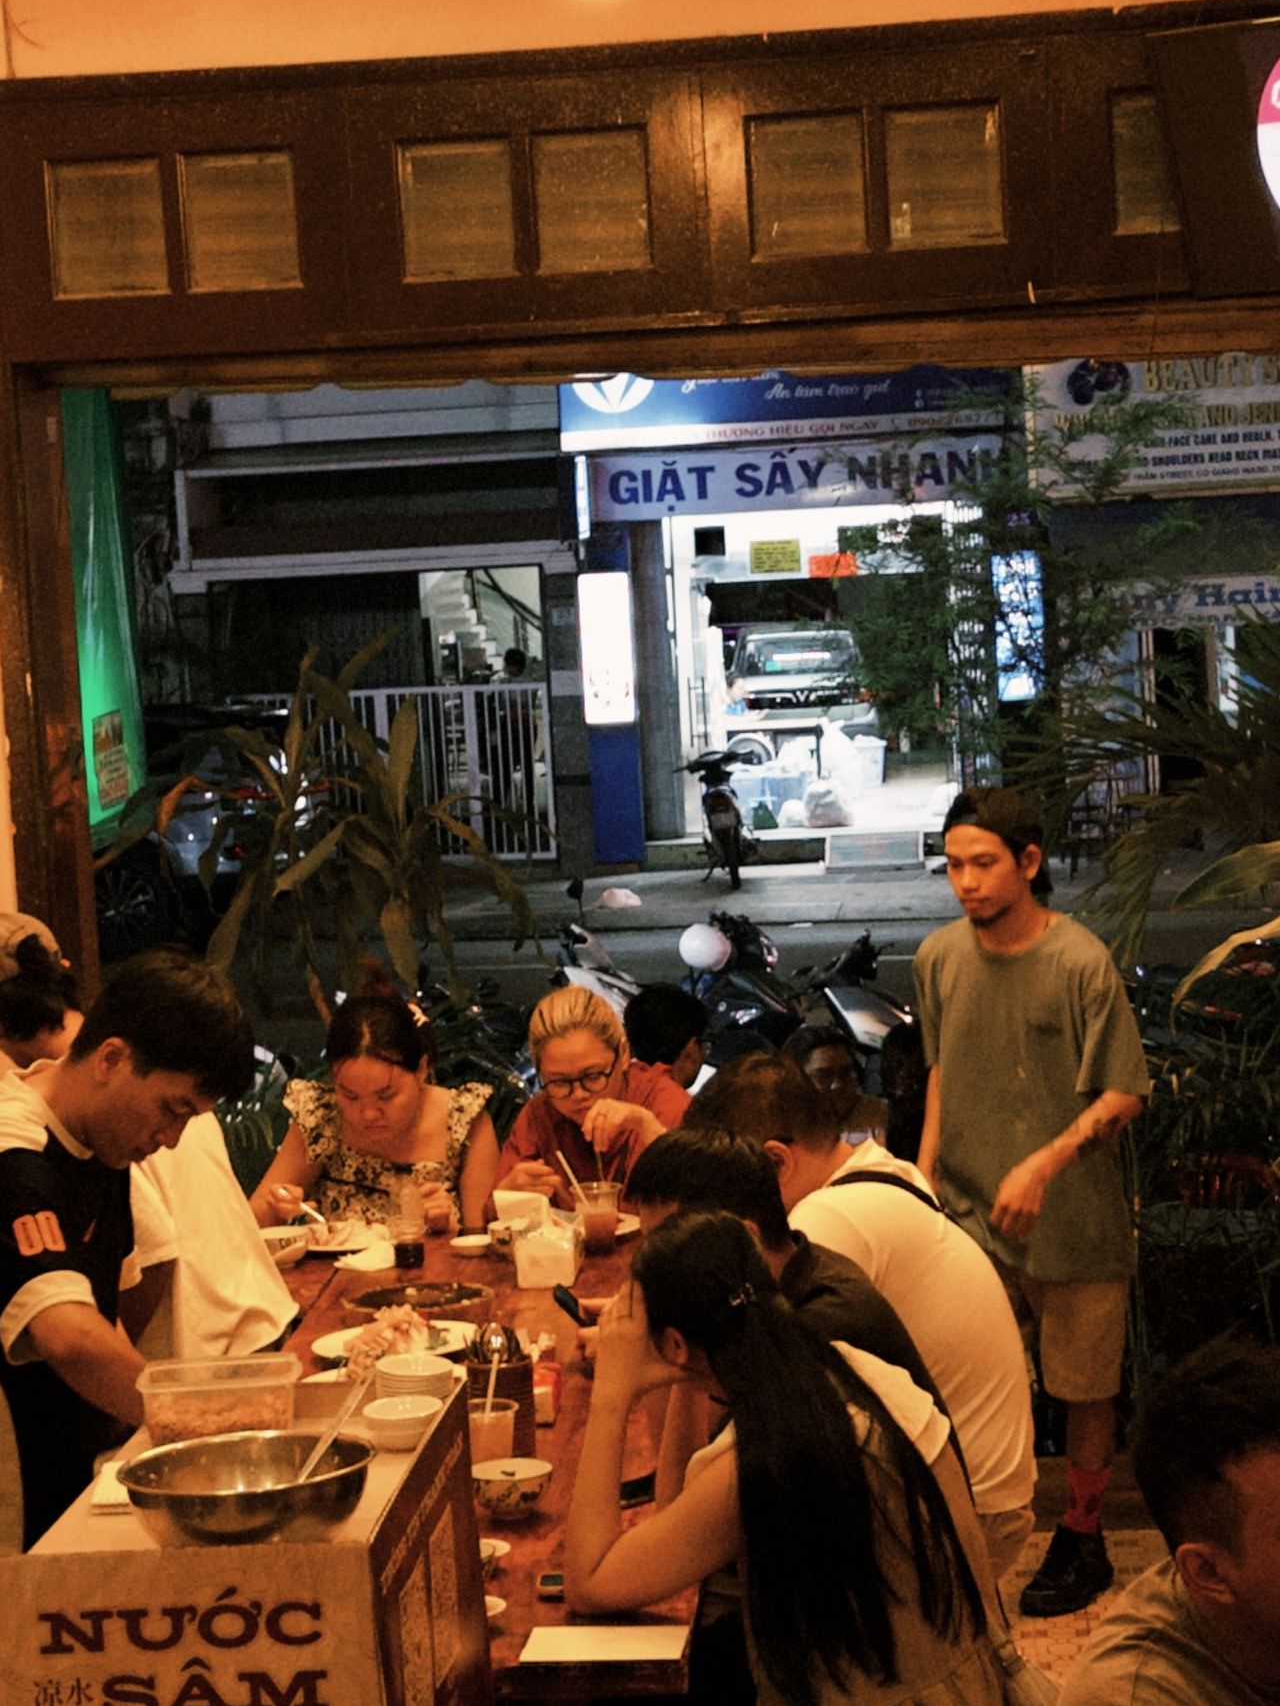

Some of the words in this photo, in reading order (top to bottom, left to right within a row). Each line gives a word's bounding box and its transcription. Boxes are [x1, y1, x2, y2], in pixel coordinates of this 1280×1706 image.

[1142, 353, 1256, 393] BEAUTY
[1152, 453, 1206, 467] SHOULDERS
[1208, 451, 1232, 463] HEAD
[1235, 449, 1259, 462] NECK
[1169, 435, 1190, 447] FACE
[1194, 433, 1218, 446] CARE
[609, 460, 715, 513] GIẶT
[735, 447, 827, 498] SẤY
[38, 1586, 322, 1654] NƯỚC
